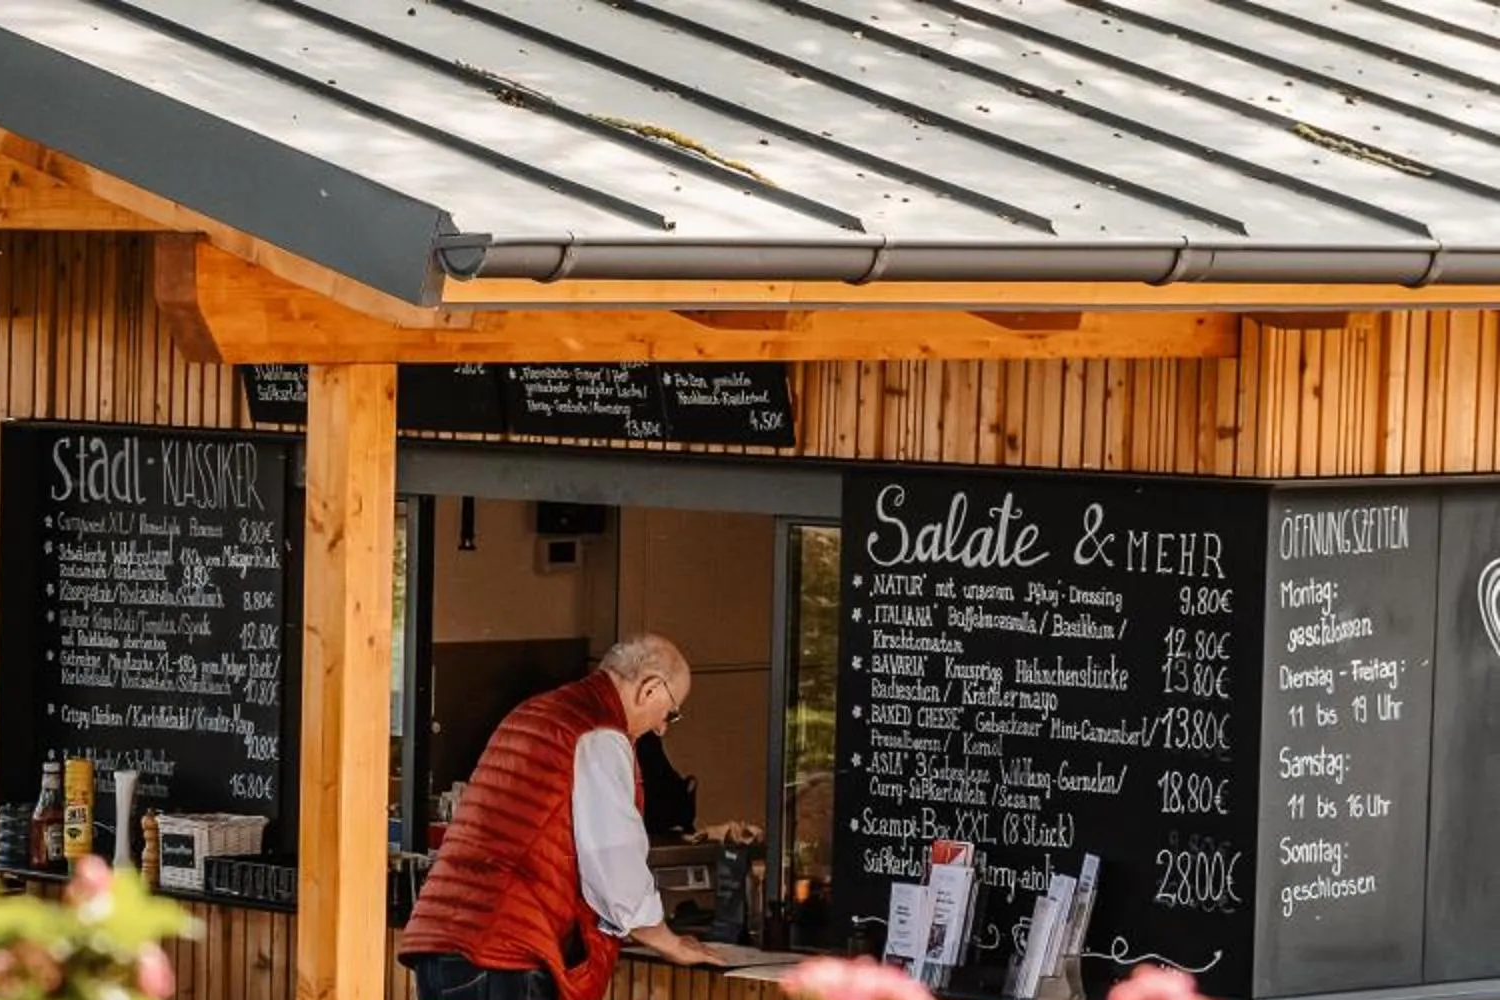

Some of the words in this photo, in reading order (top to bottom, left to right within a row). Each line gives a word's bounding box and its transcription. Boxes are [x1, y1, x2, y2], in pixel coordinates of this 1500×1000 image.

[867, 484, 1050, 568] Salate
[1073, 502, 1116, 567] &
[1125, 529, 1226, 579] MEHR
[1179, 585, 1234, 617] 9,80€
[1280, 577, 1339, 616] Montag:
[1286, 612, 1374, 653] geschlossen
[1279, 664, 1334, 694] Dienstag
[1350, 657, 1407, 689] Freitag:
[1287, 705, 1304, 727] 11
[1315, 702, 1338, 726] bis
[1351, 694, 1367, 723] 19
[1377, 693, 1404, 721] Uhr
[915, 751, 928, 778] 3
[1156, 769, 1230, 815] 18,80€
[1279, 745, 1351, 785] Samstag:
[1287, 793, 1305, 820] 11
[1316, 794, 1338, 819] bis
[1346, 793, 1364, 819] 16
[1367, 794, 1392, 817] Uhr
[1279, 836, 1349, 877] Sonntag:
[1281, 874, 1377, 918] geschlossen
